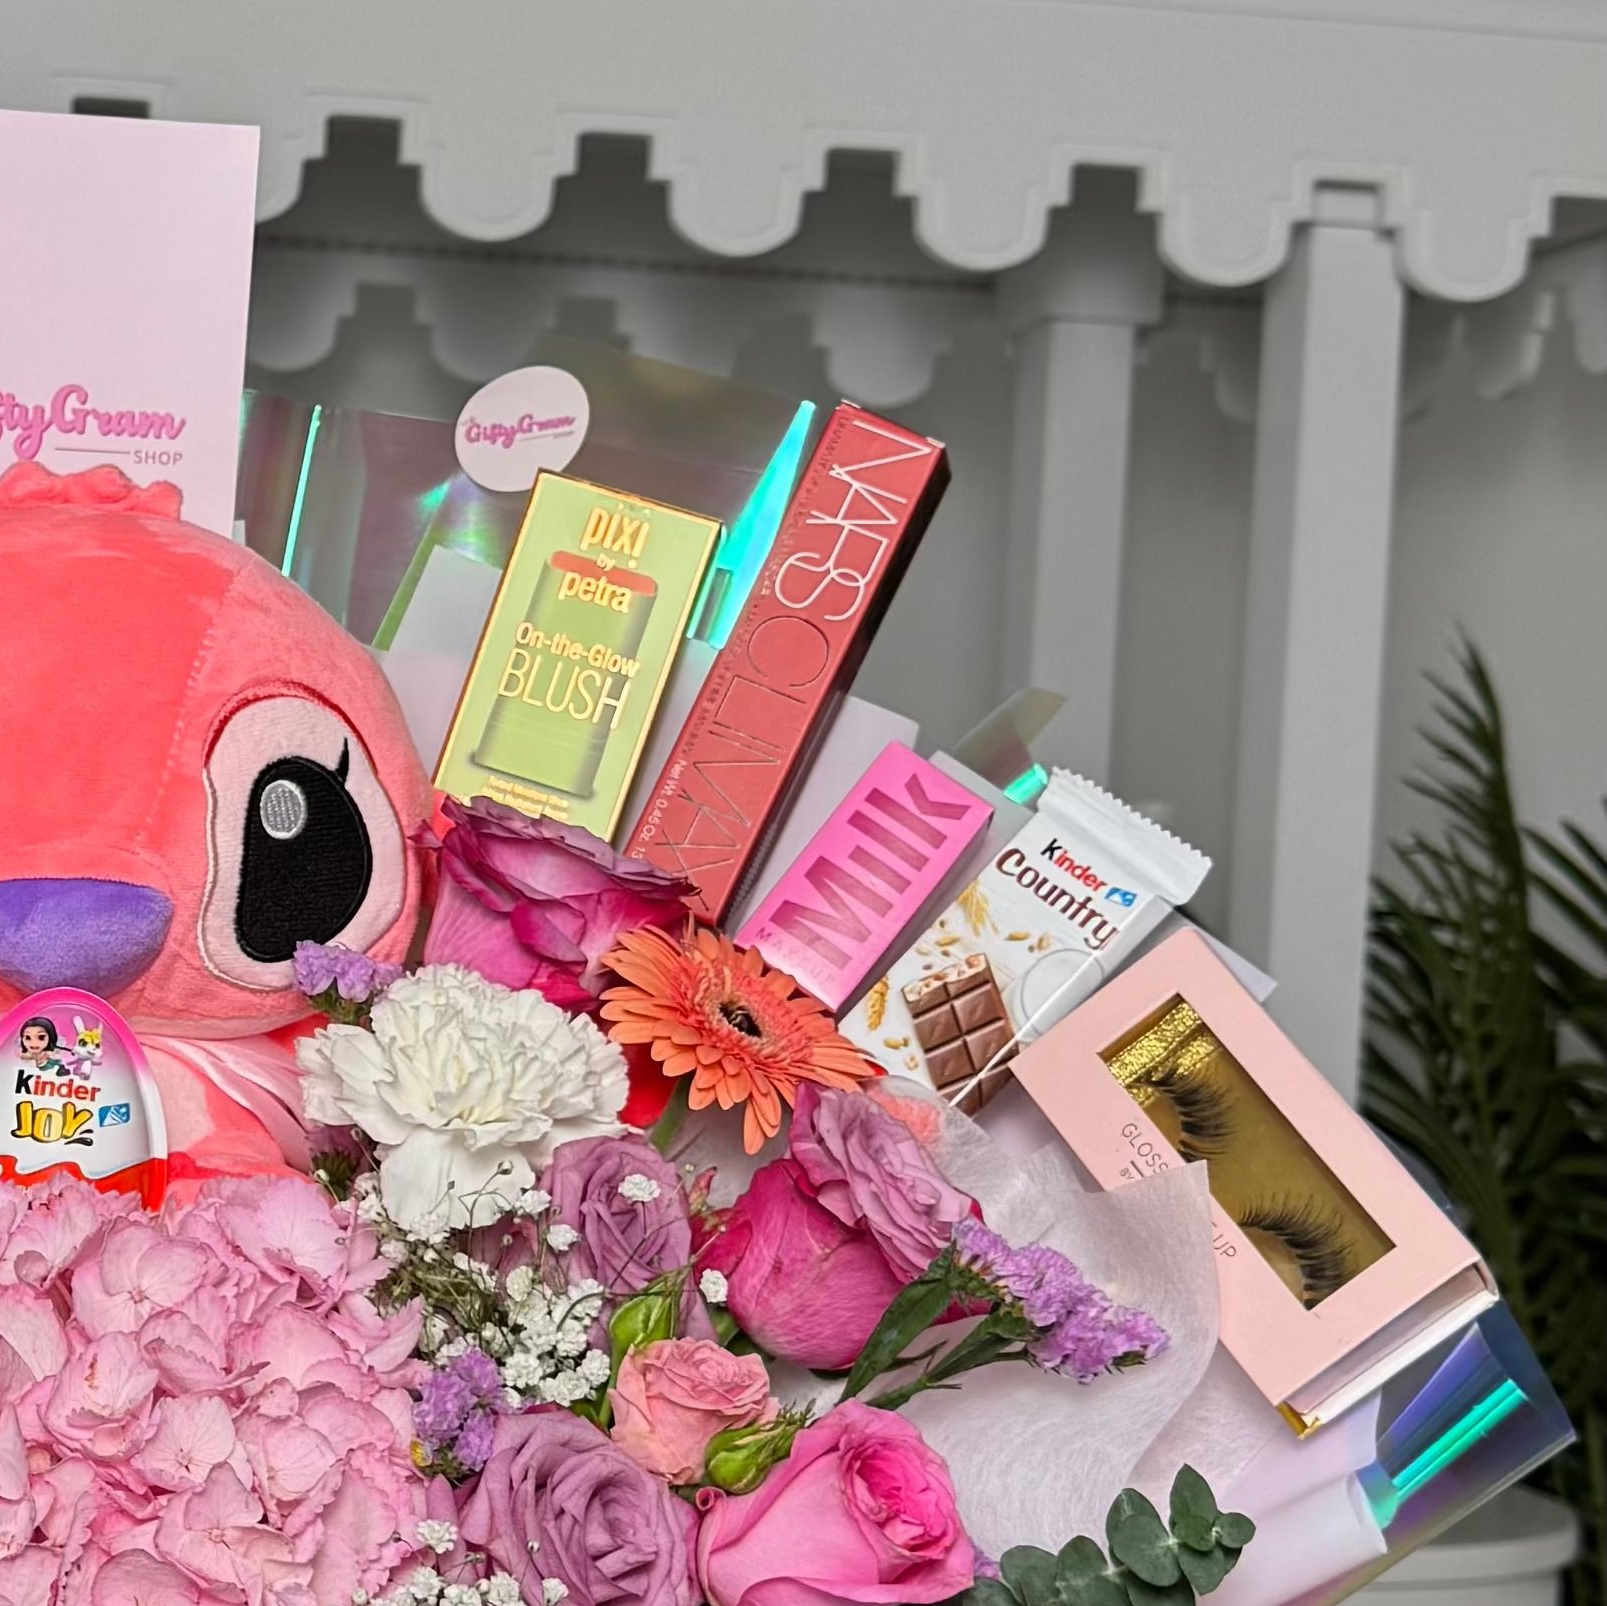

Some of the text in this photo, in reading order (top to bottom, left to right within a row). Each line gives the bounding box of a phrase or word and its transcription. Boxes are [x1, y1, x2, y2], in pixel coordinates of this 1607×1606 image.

[133, 449, 184, 467] SHOP
[775, 419, 932, 622] NARS
[596, 552, 615, 572] by
[558, 571, 633, 614] petra
[515, 622, 642, 678] On-the-Glow
[497, 648, 631, 730] BLUSH
[654, 615, 831, 912] CLIMAX
[1040, 836, 1108, 895] Kinder
[994, 847, 1119, 952] Country
[15, 1069, 101, 1102] Kinder
